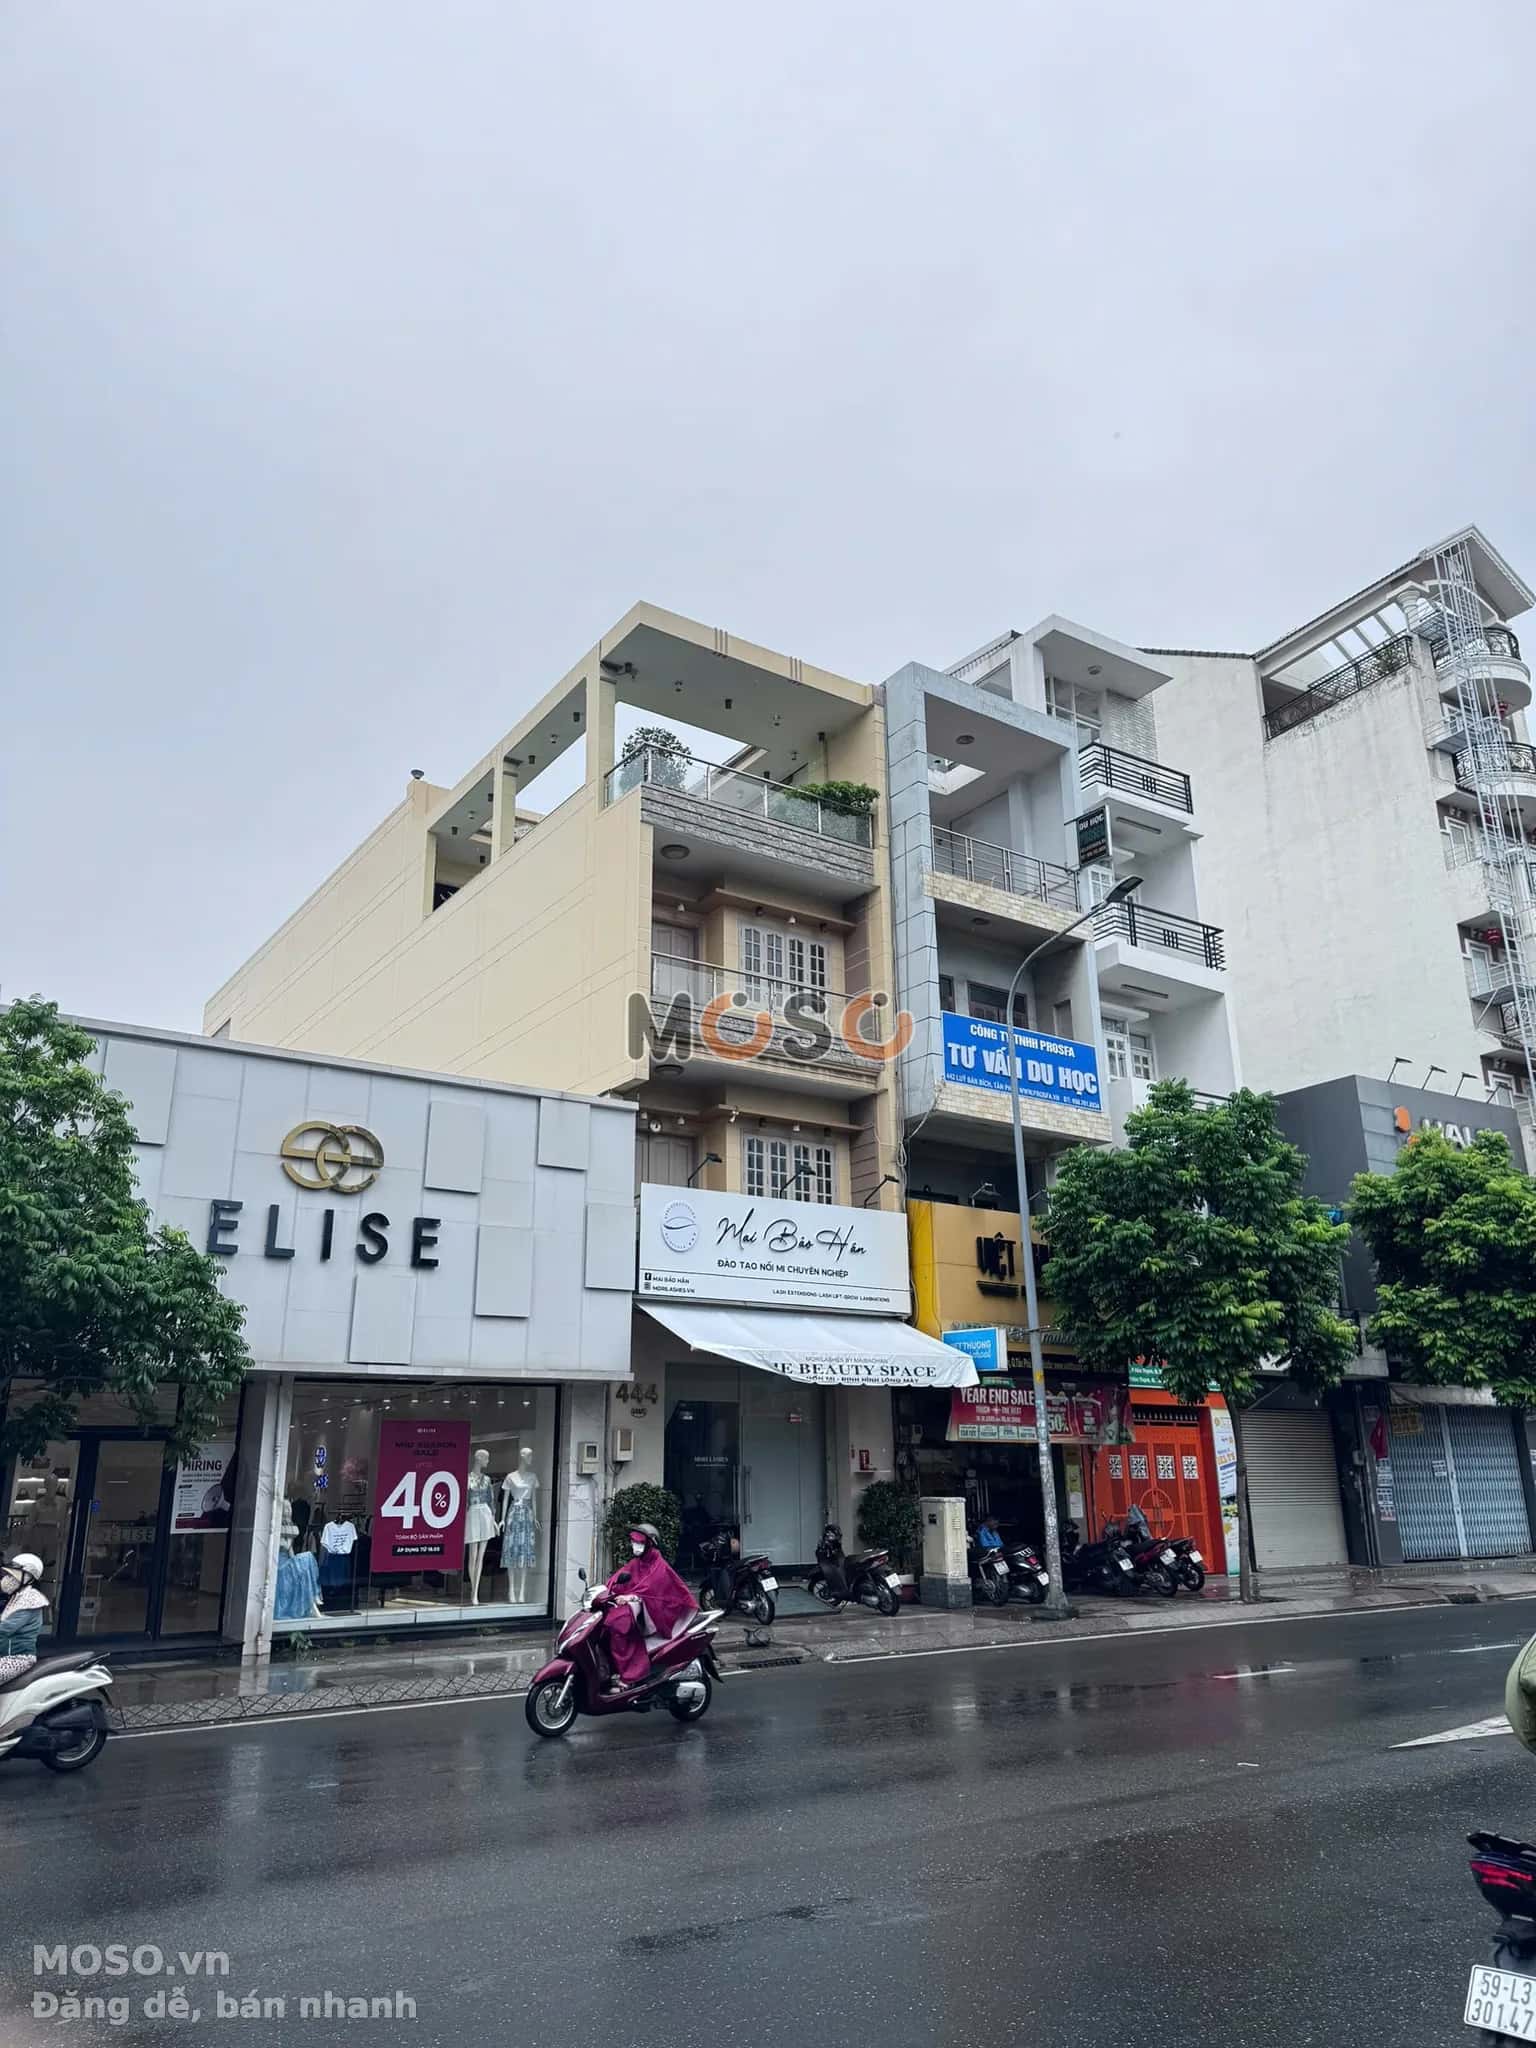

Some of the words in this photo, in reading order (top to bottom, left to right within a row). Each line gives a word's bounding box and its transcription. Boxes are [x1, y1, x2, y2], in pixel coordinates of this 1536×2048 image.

[970, 1023, 997, 1040] CÔNG
[1014, 1033, 1039, 1049] TNHH
[1040, 1039, 1075, 1058] PROSFA
[948, 1043, 976, 1069] TƯ
[1027, 1059, 1054, 1085] DU
[1058, 1066, 1098, 1096] HỌC
[206, 1199, 442, 1269] ELISE
[716, 1207, 757, 1250] Mai
[717, 1256, 737, 1269] ĐÀO
[740, 1261, 758, 1271] TẠO
[776, 1265, 785, 1273] MI
[787, 1264, 820, 1276] CHUYÊN
[800, 1363, 875, 1377] BEAUTY
[880, 1364, 938, 1378] SPACE
[616, 1383, 657, 1404] 444
[961, 1387, 988, 1404] YEAR
[989, 1388, 1009, 1405] END
[1010, 1390, 1035, 1406] SALE
[381, 1470, 460, 1529] 40
[1480, 1972, 1532, 2005] 59-L3
[1471, 1999, 1534, 2034] 301.47
